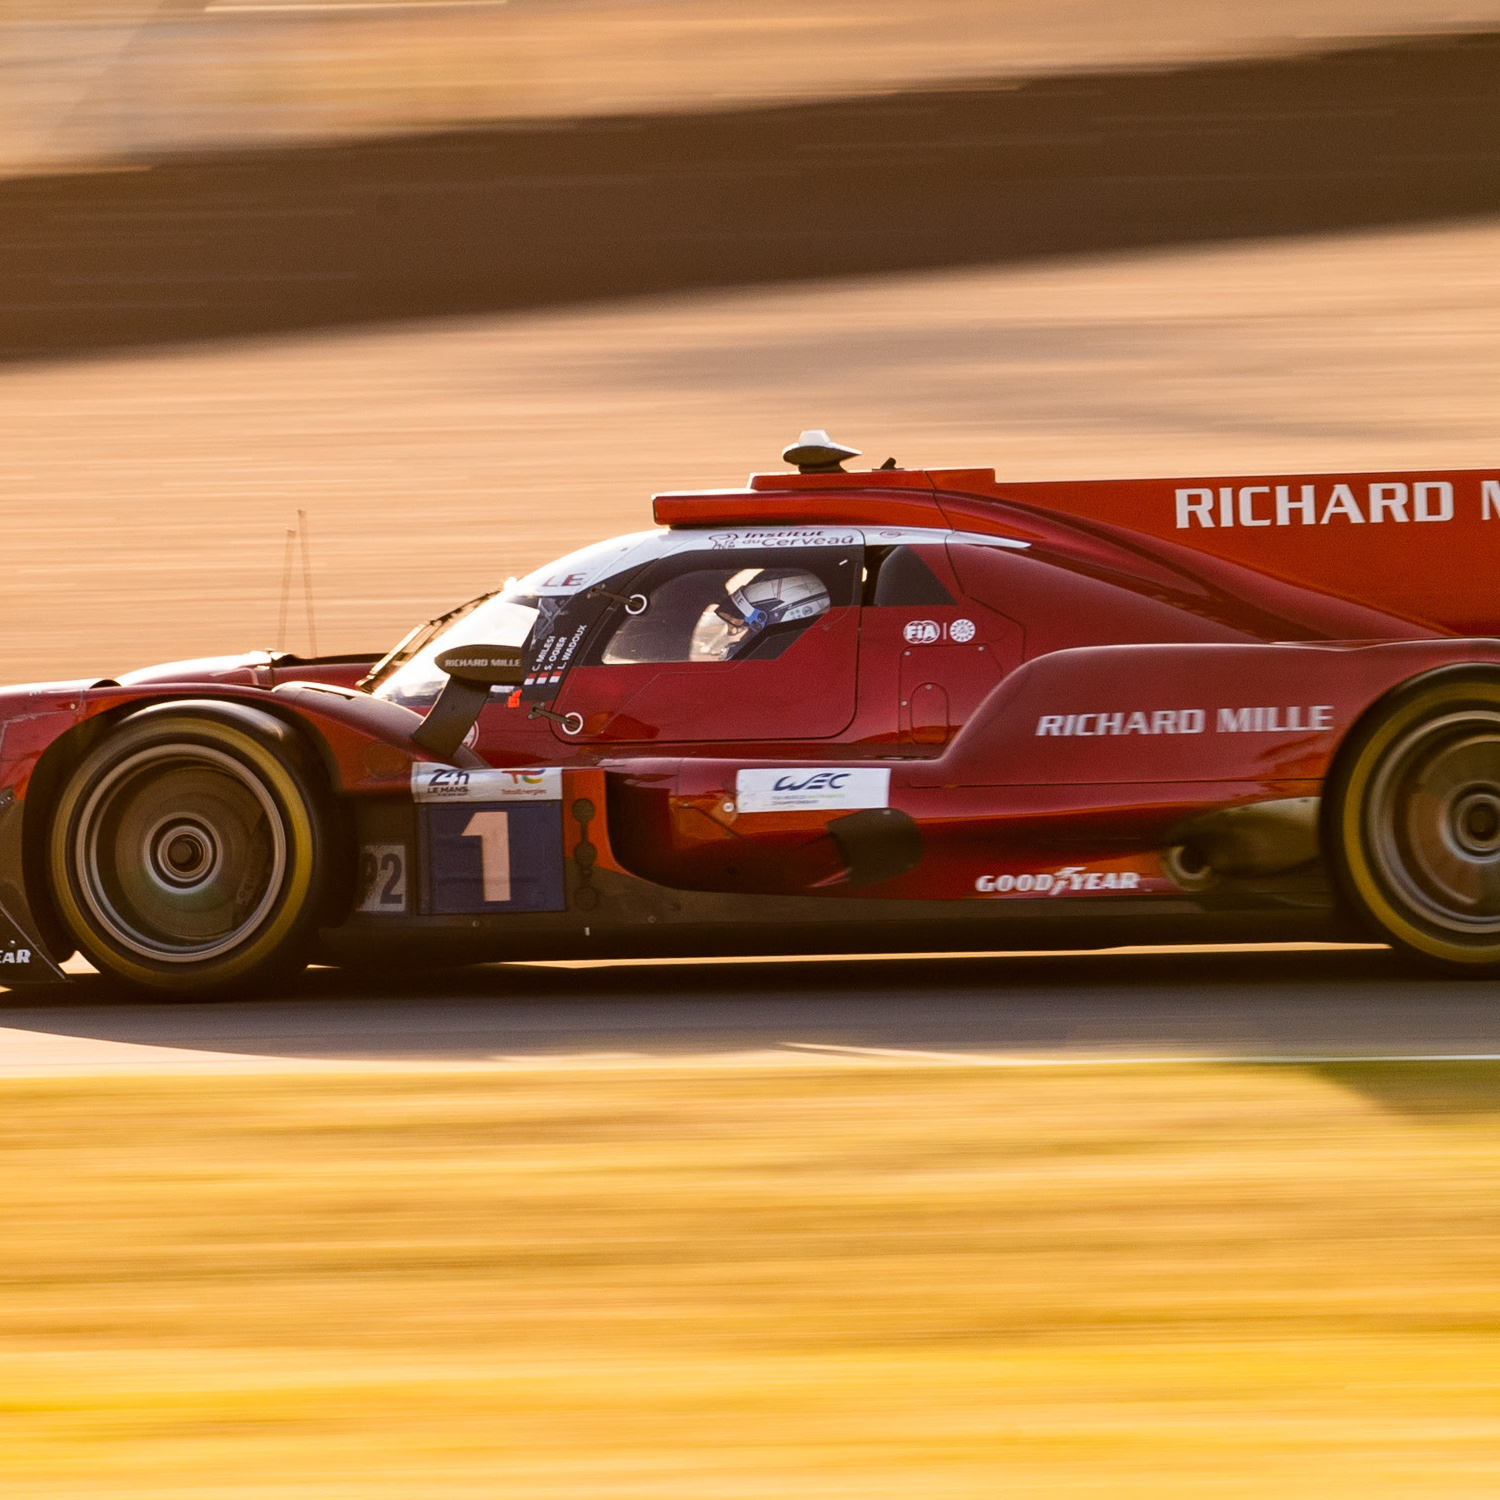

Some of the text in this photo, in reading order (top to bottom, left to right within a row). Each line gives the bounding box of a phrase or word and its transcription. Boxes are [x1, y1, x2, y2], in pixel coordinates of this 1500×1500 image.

[1174, 481, 1455, 530] RICHARD
[744, 529, 825, 539] Institut
[761, 535, 854, 547] Cerveau
[906, 624, 937, 640] FIA
[531, 635, 556, 672] C. MILESI
[543, 636, 568, 671] S. OGIER
[556, 624, 588, 670] L. WADOUX
[444, 658, 522, 668] RICHARD MILLE
[1034, 704, 1335, 737] RICHARD MILLE
[426, 785, 469, 794] LE MANS
[772, 772, 852, 791] WEC
[461, 811, 512, 902] 1
[974, 870, 1140, 893] GOODYEAR
